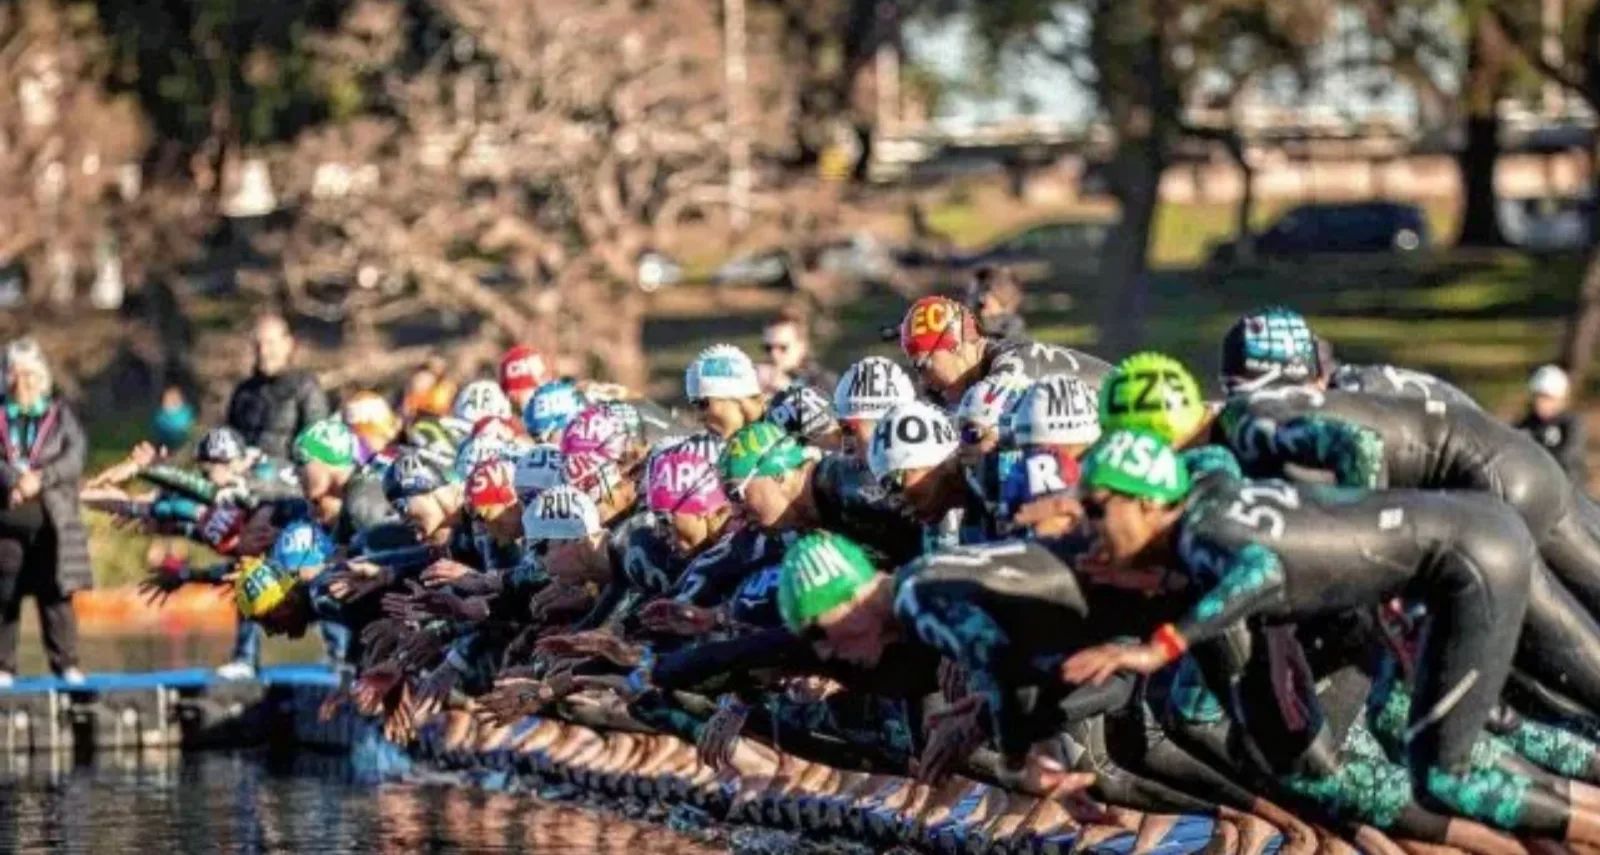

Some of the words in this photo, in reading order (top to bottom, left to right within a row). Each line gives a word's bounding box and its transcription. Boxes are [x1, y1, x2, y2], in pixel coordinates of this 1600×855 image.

[847, 361, 900, 397] MEX
[872, 415, 953, 455] HON
[1105, 430, 1179, 490] RSA
